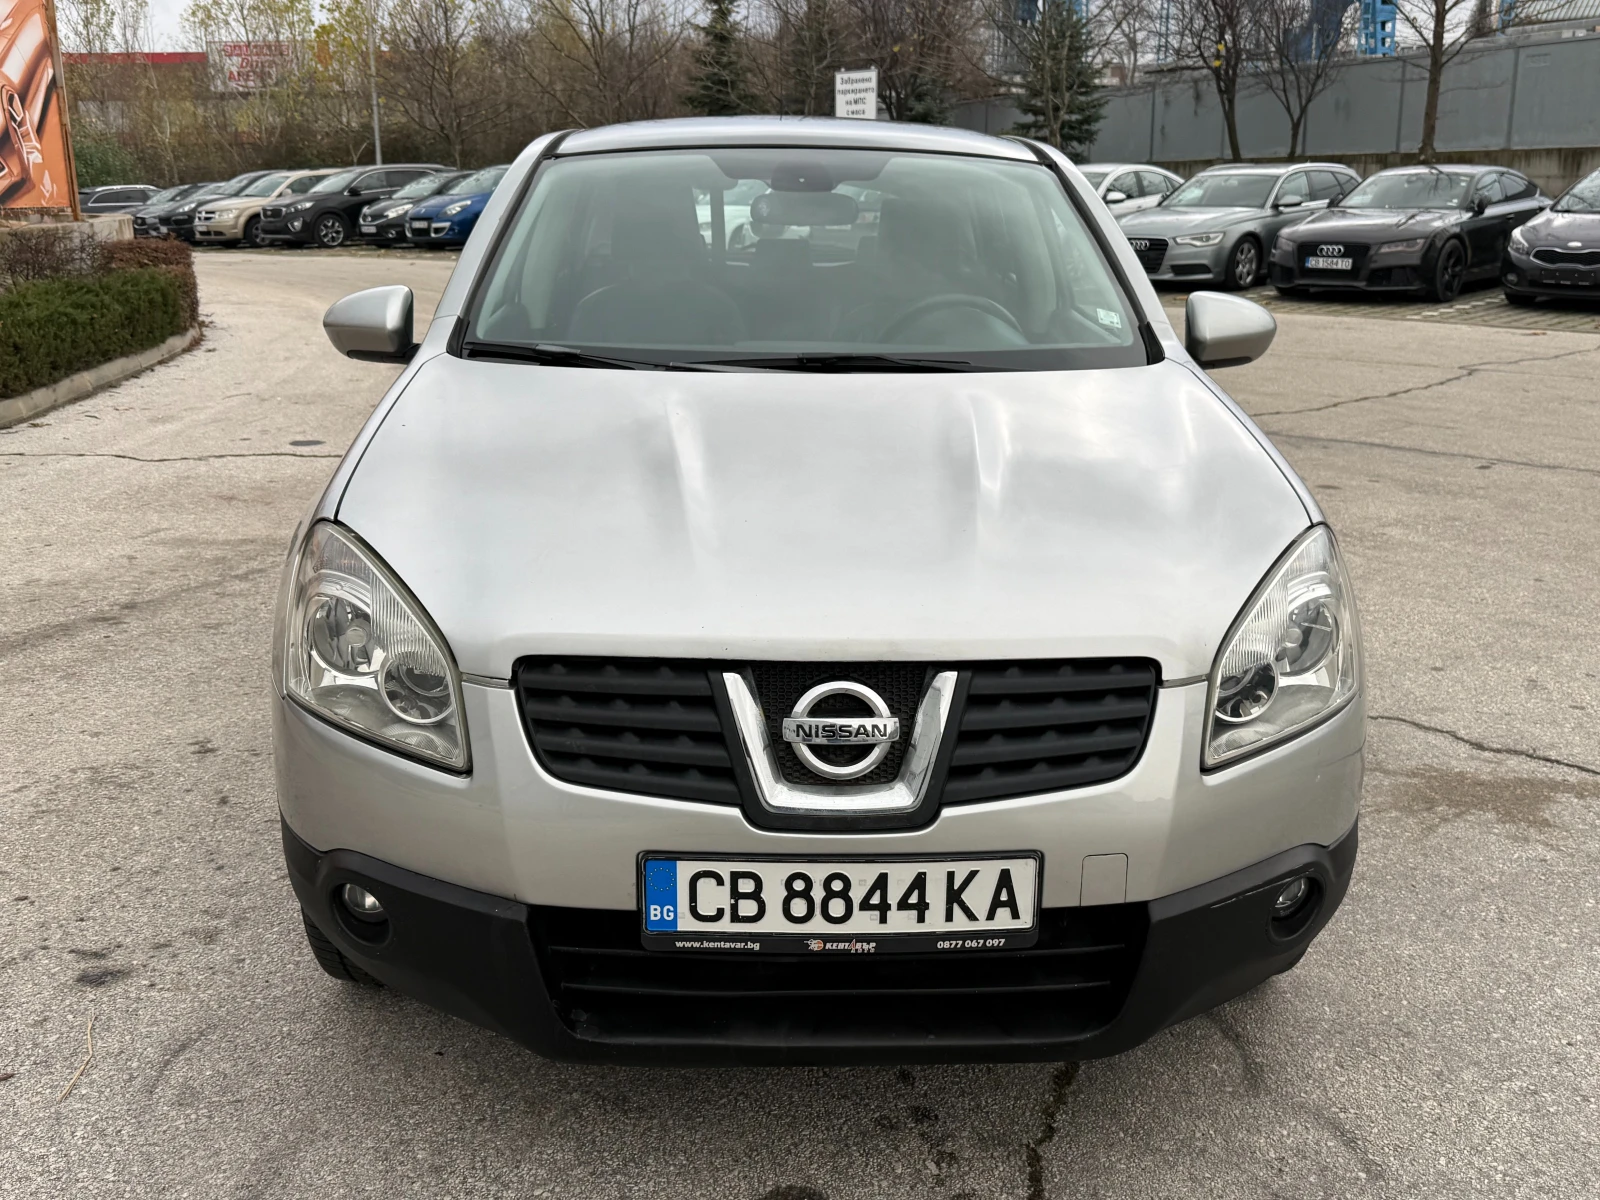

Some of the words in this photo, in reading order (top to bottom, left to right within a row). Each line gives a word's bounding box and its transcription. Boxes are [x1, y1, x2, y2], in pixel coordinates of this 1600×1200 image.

[853, 97, 866, 105] МПС
[796, 724, 887, 738] NISSAN
[689, 870, 766, 923] CB
[782, 871, 930, 924] 8844
[945, 868, 1021, 922] KA
[650, 905, 674, 920] BG
[675, 940, 760, 950] www.kentavar.bg
[937, 940, 961, 949] 0877
[964, 940, 984, 948] 067
[986, 939, 1005, 947] 097
